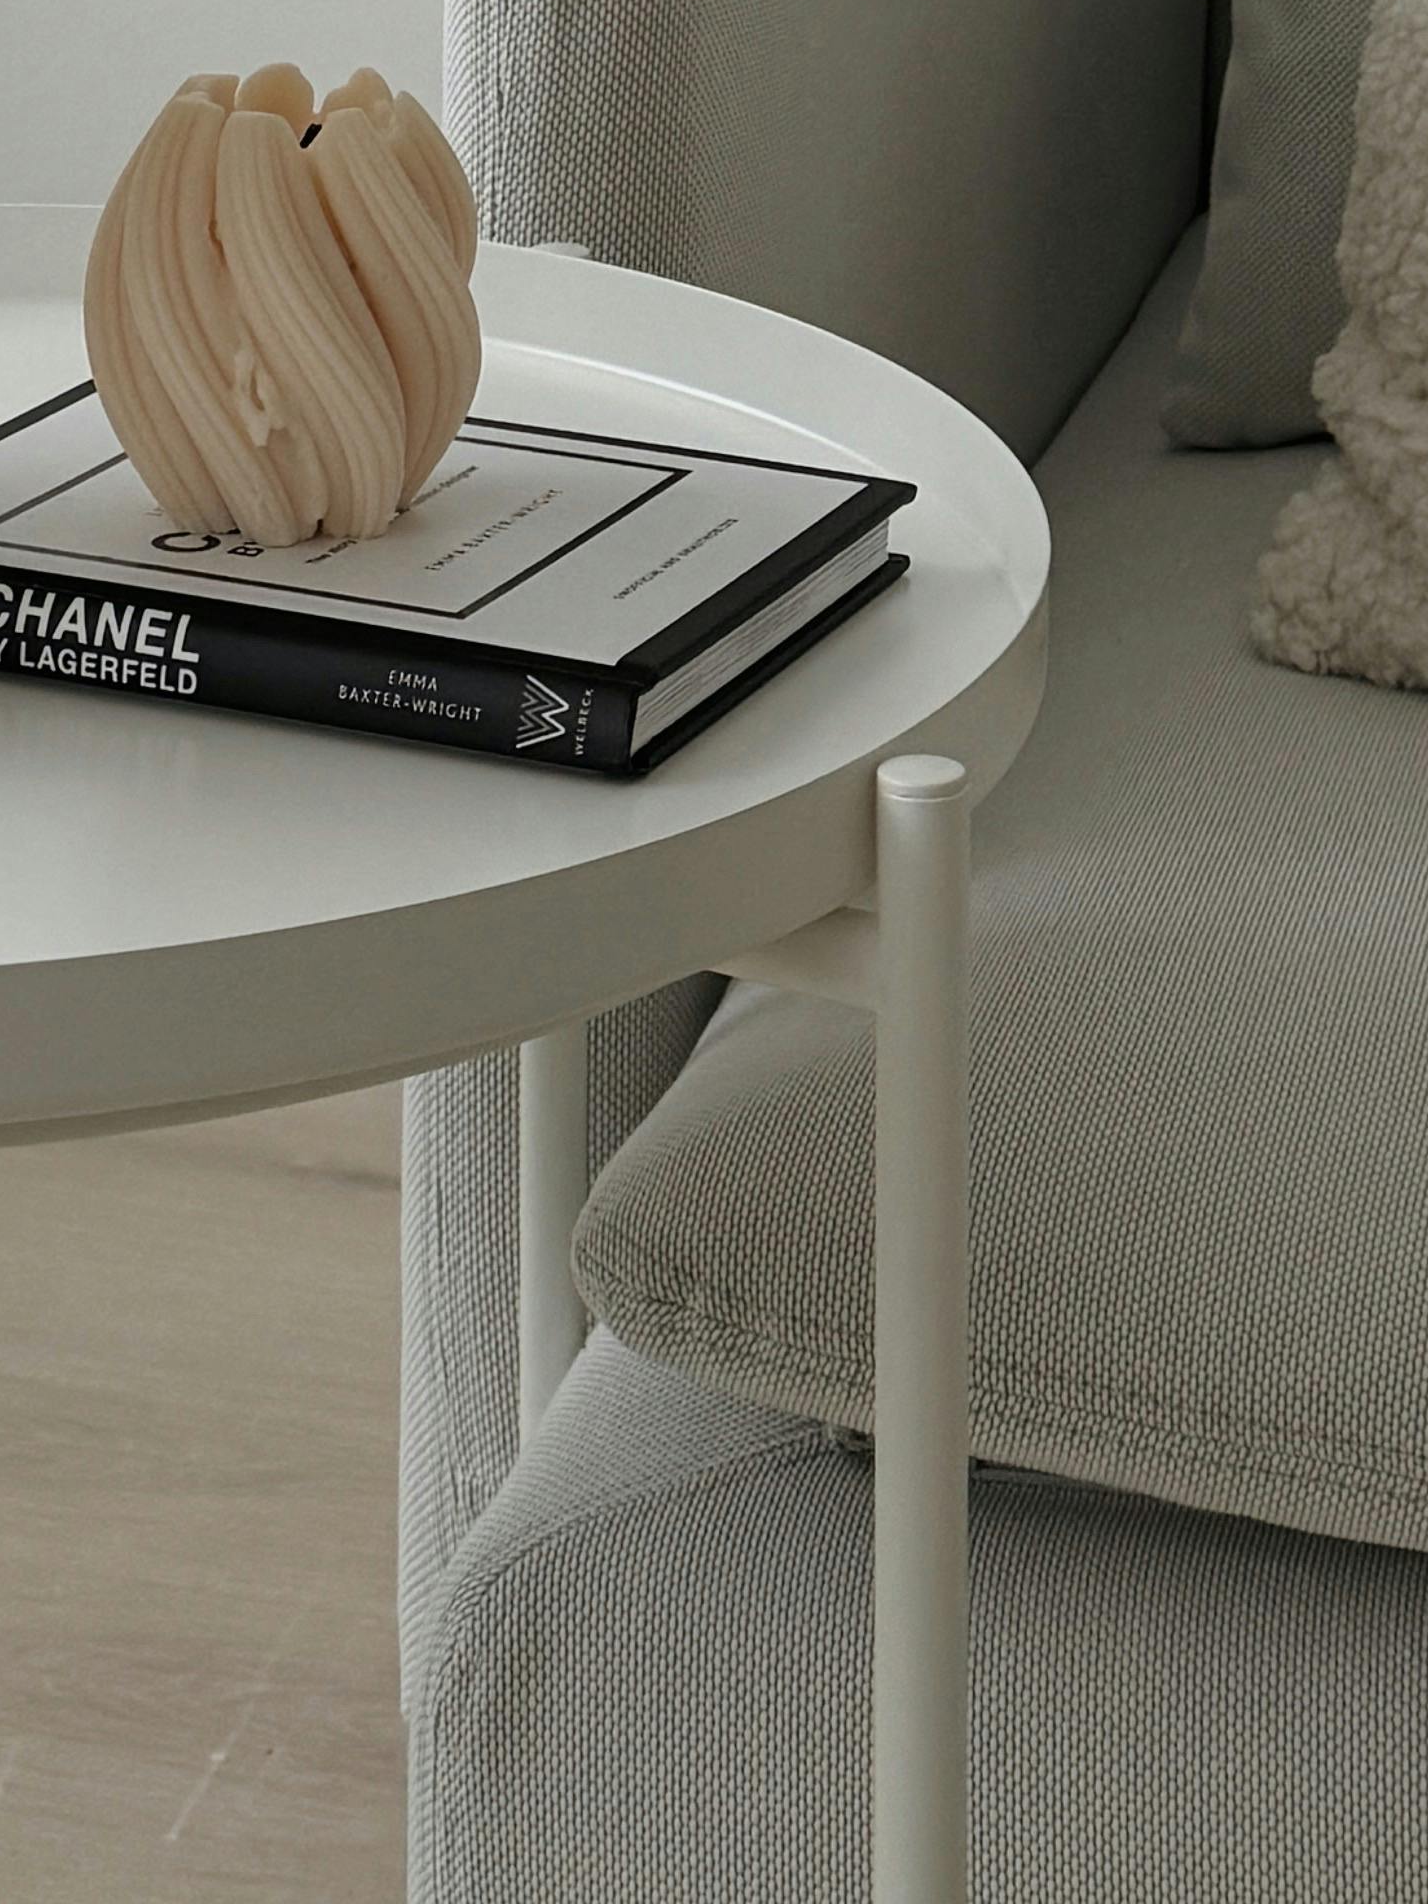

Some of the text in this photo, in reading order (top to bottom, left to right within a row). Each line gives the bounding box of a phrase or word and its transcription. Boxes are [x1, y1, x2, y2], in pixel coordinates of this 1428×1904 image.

[19, 641, 199, 695] LAGERFELD
[387, 669, 438, 692] EMMA
[337, 683, 483, 722] BAXTER-WRIGHT
[574, 687, 595, 756] WELBECK
